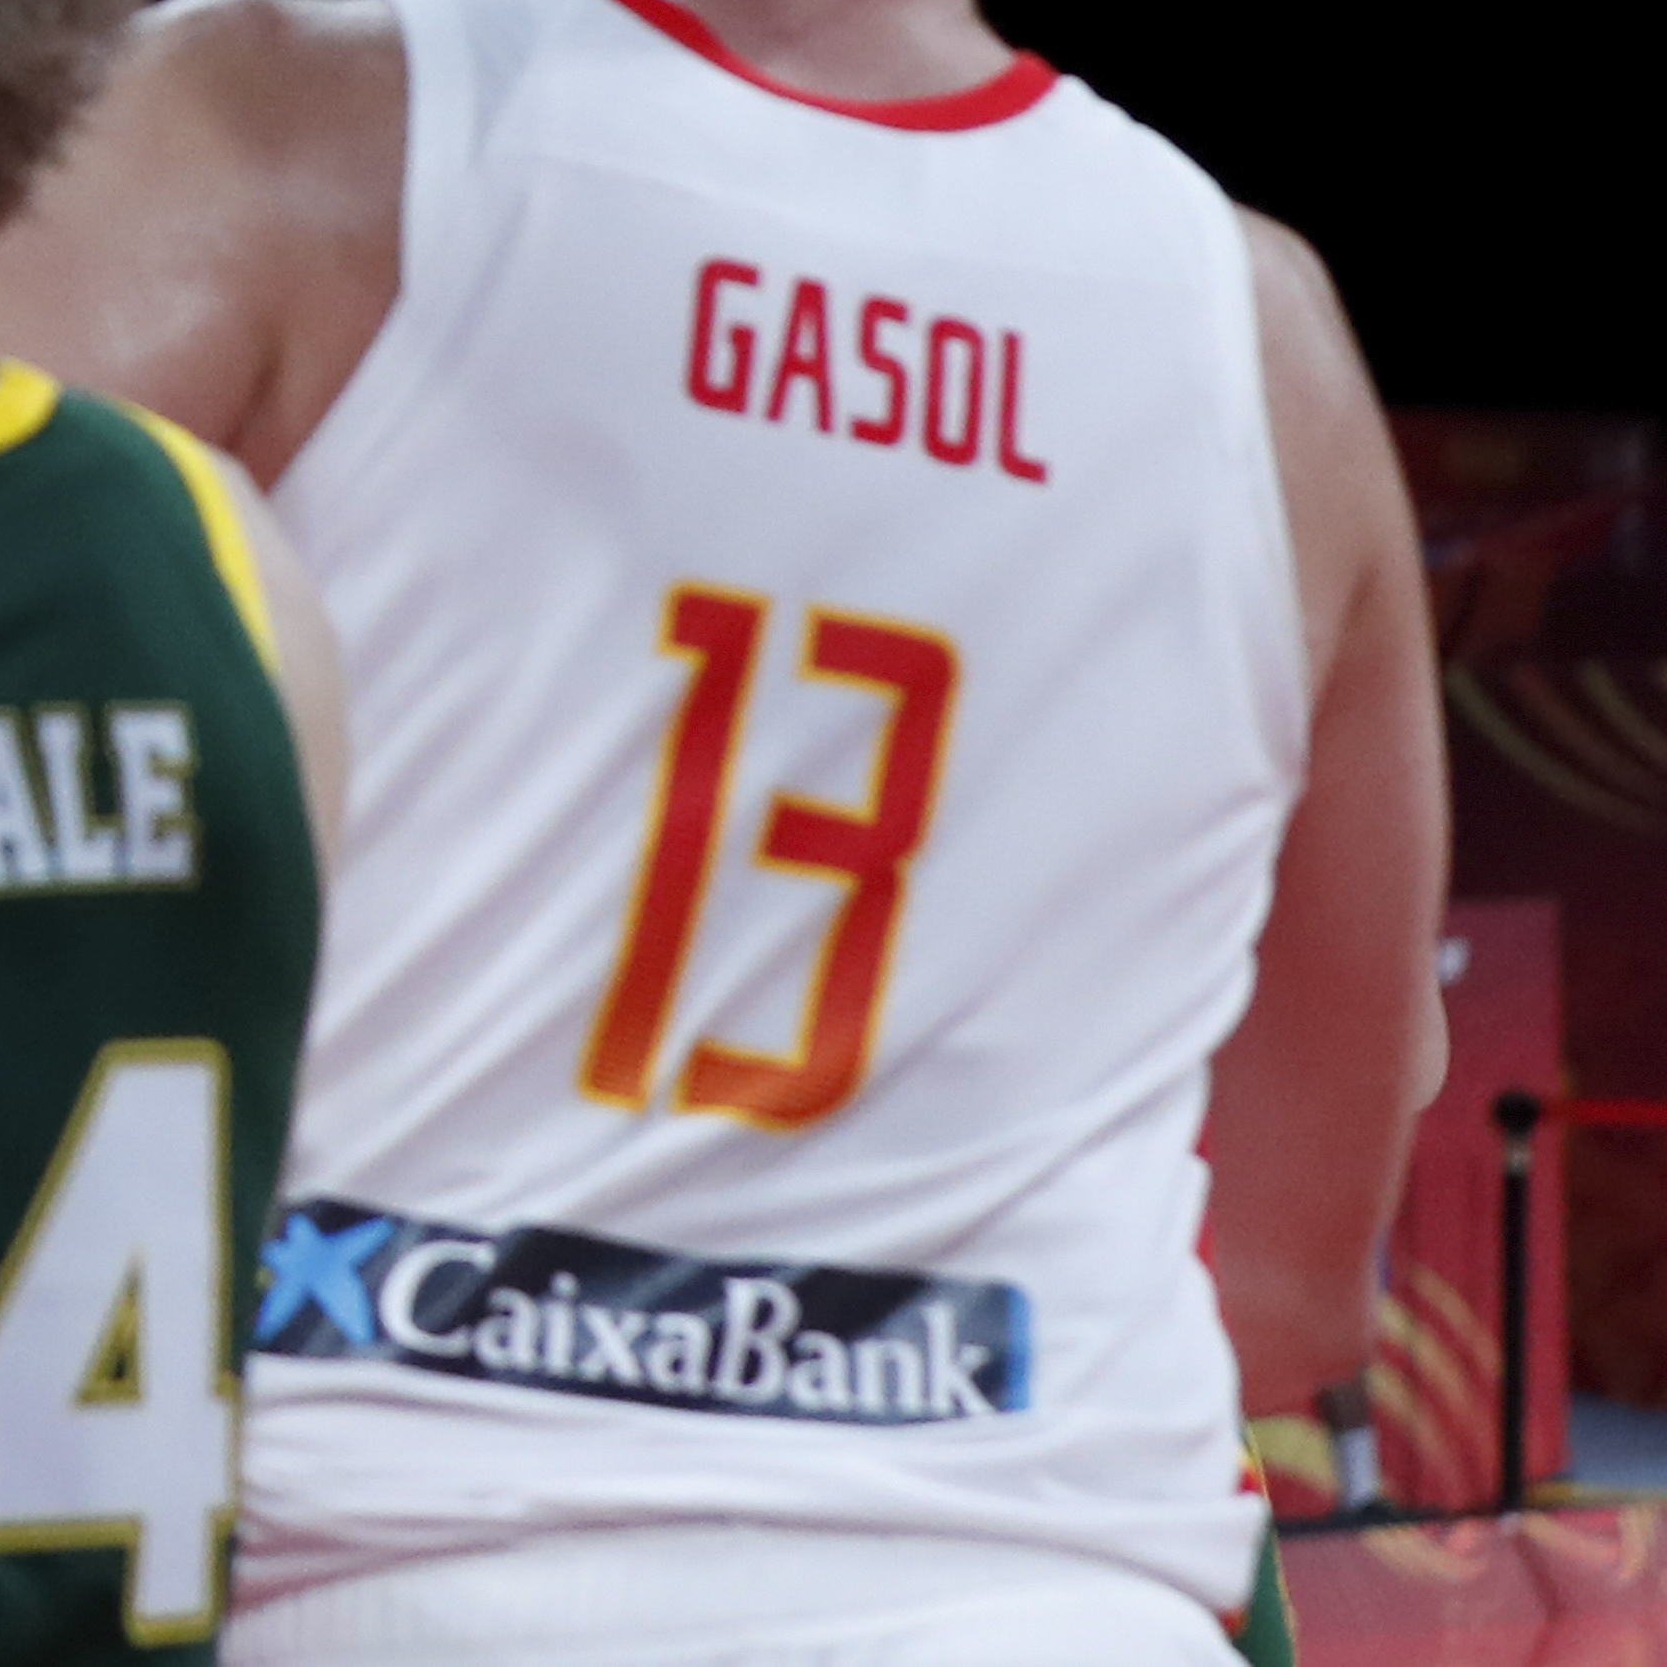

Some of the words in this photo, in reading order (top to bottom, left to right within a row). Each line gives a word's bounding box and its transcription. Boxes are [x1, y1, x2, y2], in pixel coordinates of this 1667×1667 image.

[686, 257, 1048, 484] GASOL
[575, 579, 961, 1132] 13
[378, 1240, 1000, 1417] CaixaBank
